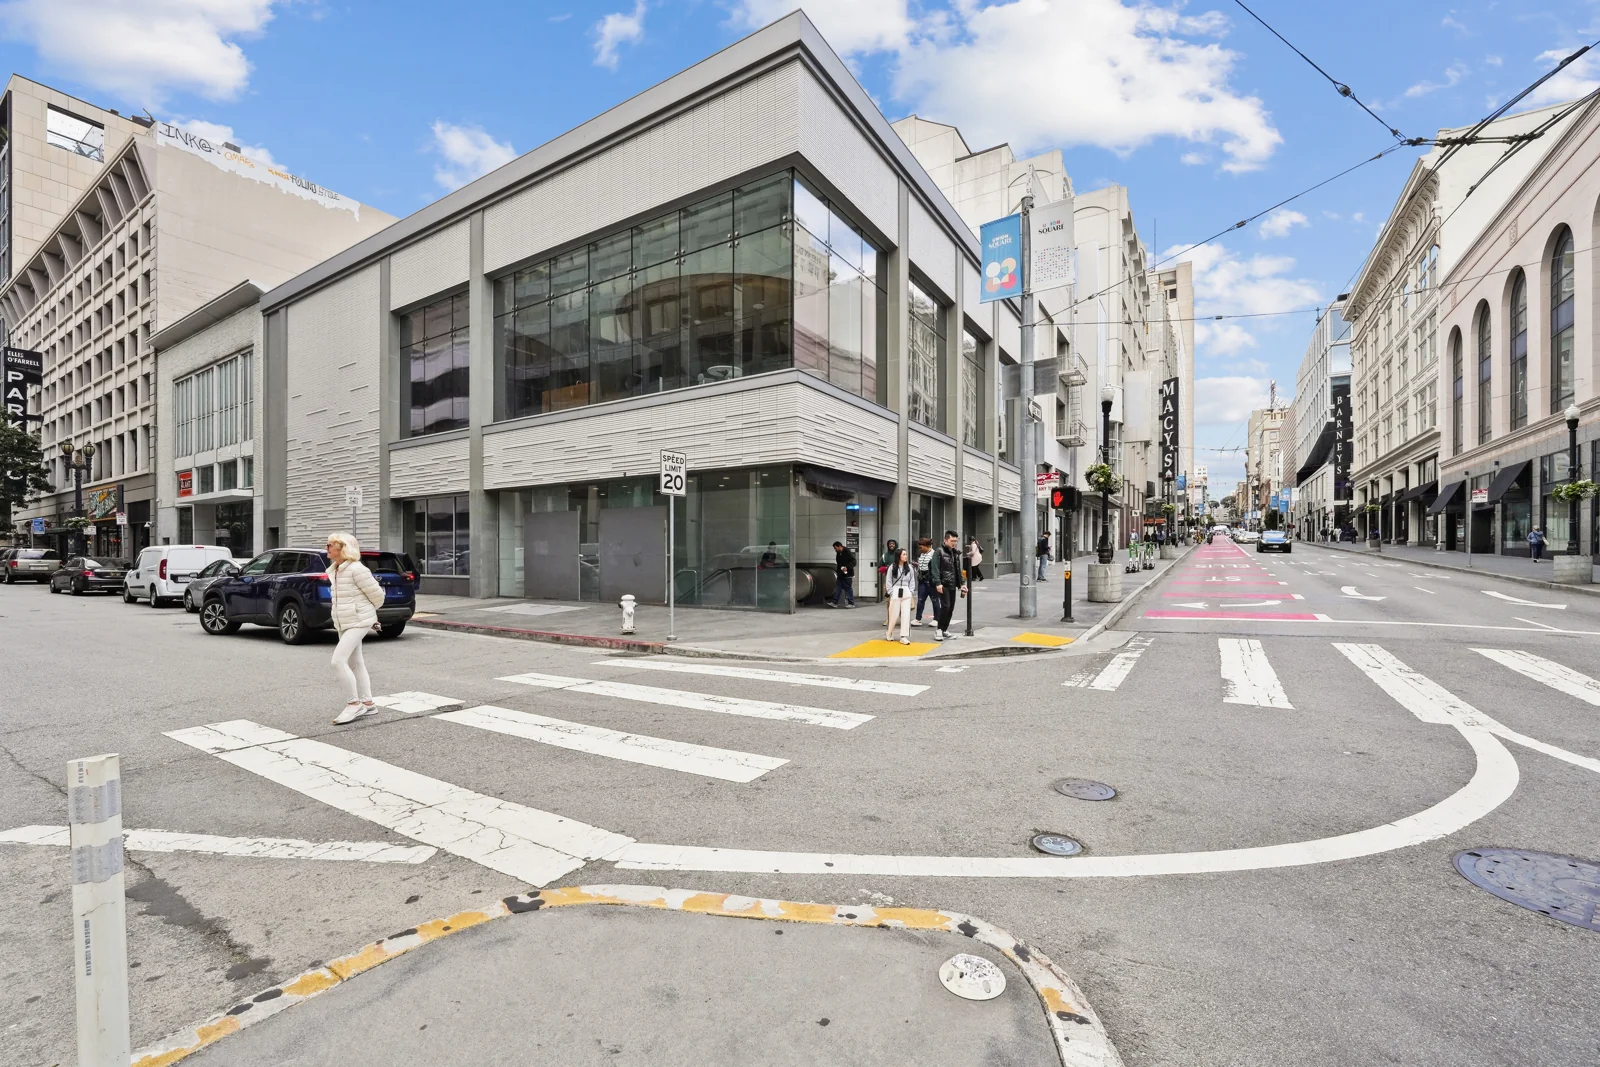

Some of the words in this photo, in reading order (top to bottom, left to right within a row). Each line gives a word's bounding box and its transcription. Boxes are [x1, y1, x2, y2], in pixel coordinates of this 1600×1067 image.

[1038, 223, 1064, 235] SQUARE
[1042, 219, 1061, 228] UION
[988, 237, 1013, 249] SQUARE
[992, 234, 1009, 243] UNION
[7, 350, 24, 358] ELLIS
[7, 356, 40, 367] O'FARRELL
[662, 454, 685, 465] SPEED
[664, 464, 682, 473] LIMIT
[663, 473, 684, 491] 20
